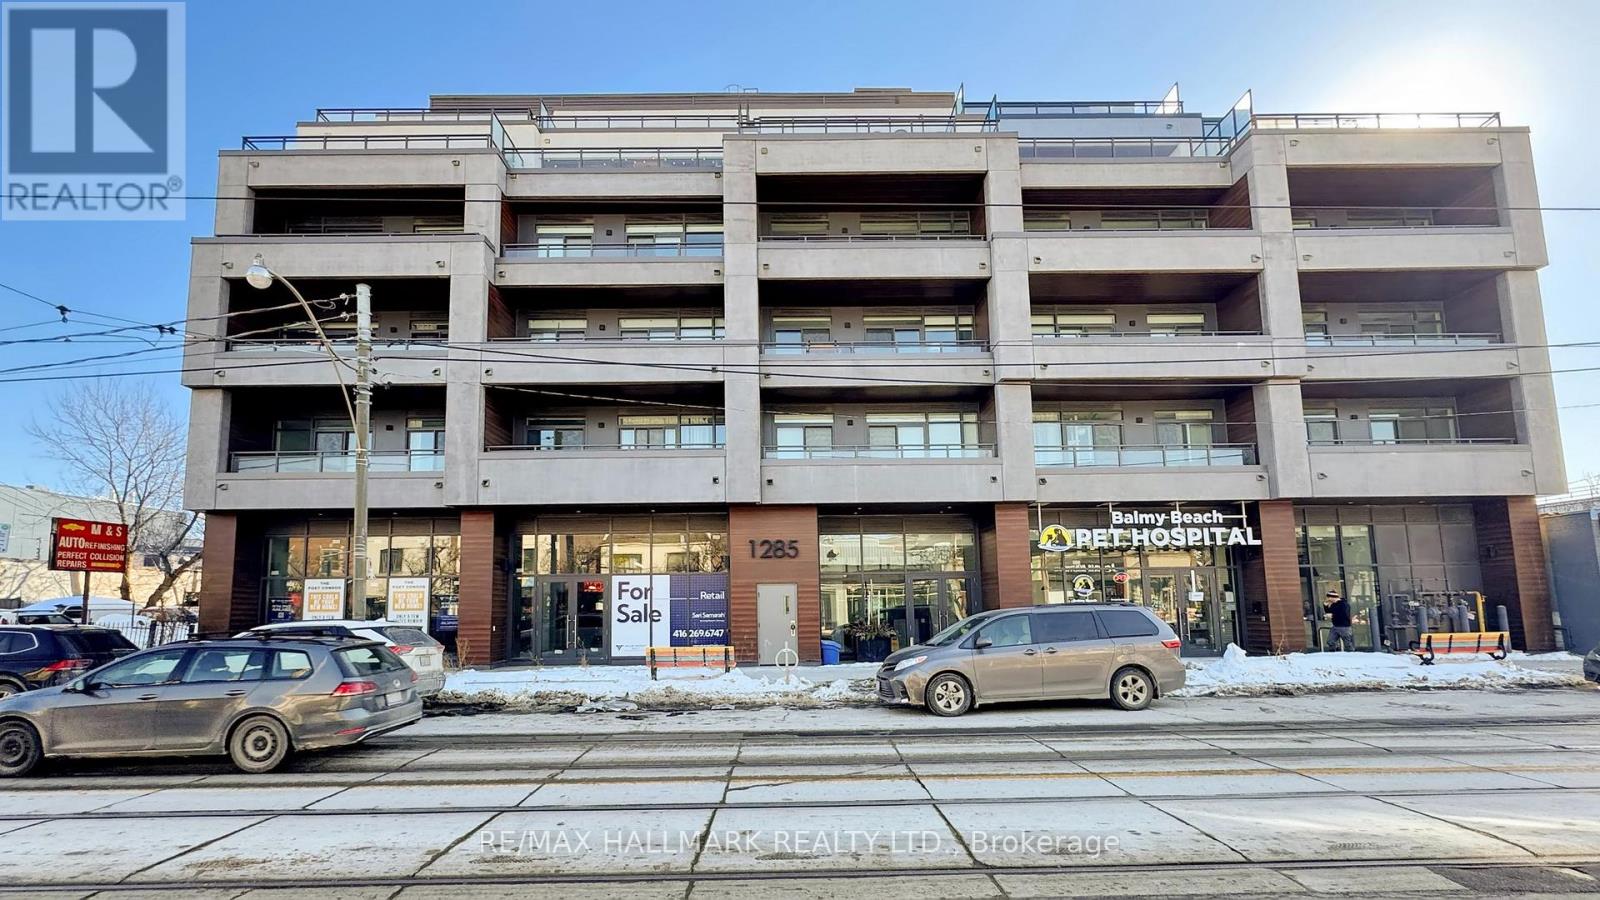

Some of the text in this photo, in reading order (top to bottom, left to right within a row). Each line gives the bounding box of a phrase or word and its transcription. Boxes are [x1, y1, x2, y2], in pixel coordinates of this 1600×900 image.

[1111, 510, 1224, 527] Balmy Beach
[91, 524, 123, 537] M & S
[1076, 527, 1262, 547] PET HOSPITAL
[59, 536, 85, 548] AUTO
[57, 551, 125, 561] PERFECT COLLISION
[748, 539, 799, 560] 1285
[56, 560, 87, 568] REPAIRS
[618, 581, 653, 600] For
[700, 591, 725, 600] Retail
[617, 603, 662, 623] Sale
[672, 629, 724, 638] 416 269.6747
